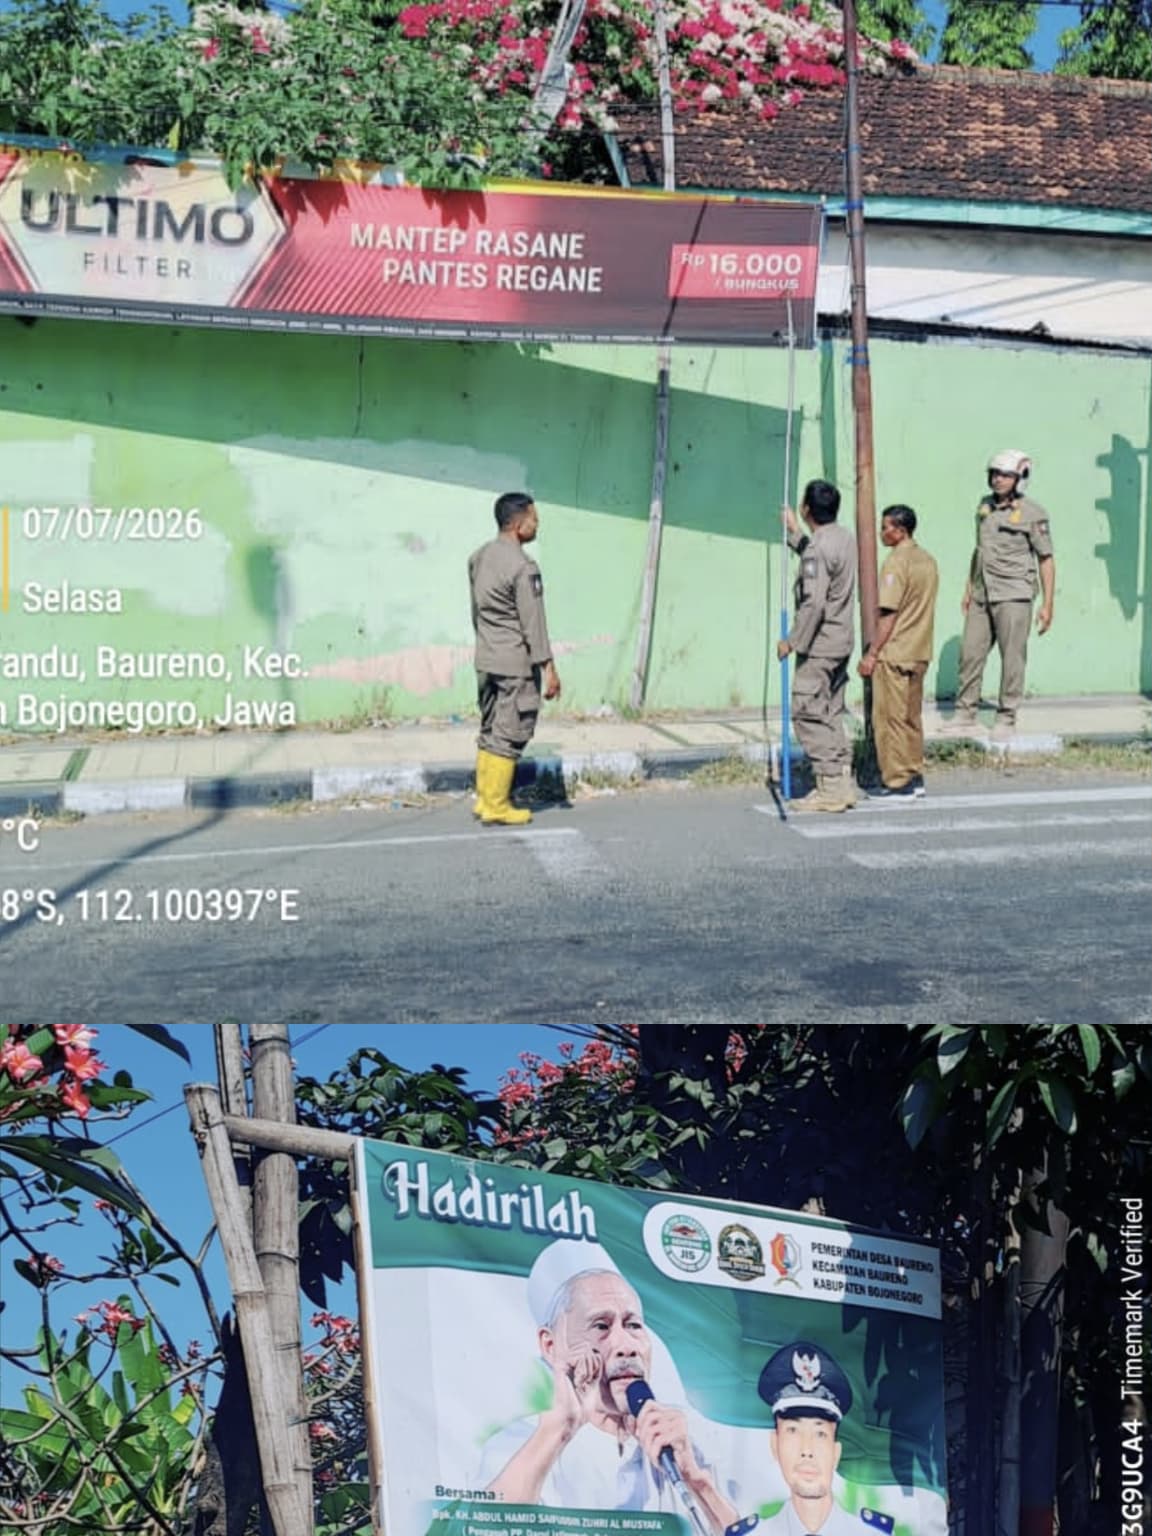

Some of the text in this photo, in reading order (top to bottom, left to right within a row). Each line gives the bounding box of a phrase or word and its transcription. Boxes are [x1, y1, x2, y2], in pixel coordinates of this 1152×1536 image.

[21, 187, 254, 247] ULTIMO
[351, 223, 586, 261] MANTEP RASANE
[84, 252, 193, 279] FILTER
[382, 259, 604, 294] PANTES REGANE
[709, 252, 803, 275] 16.000
[383, 1161, 599, 1241] Hadirilah
[870, 1252, 893, 1265] DESA
[813, 1278, 866, 1294] KABUPATEN
[435, 1485, 496, 1501] Bersama
